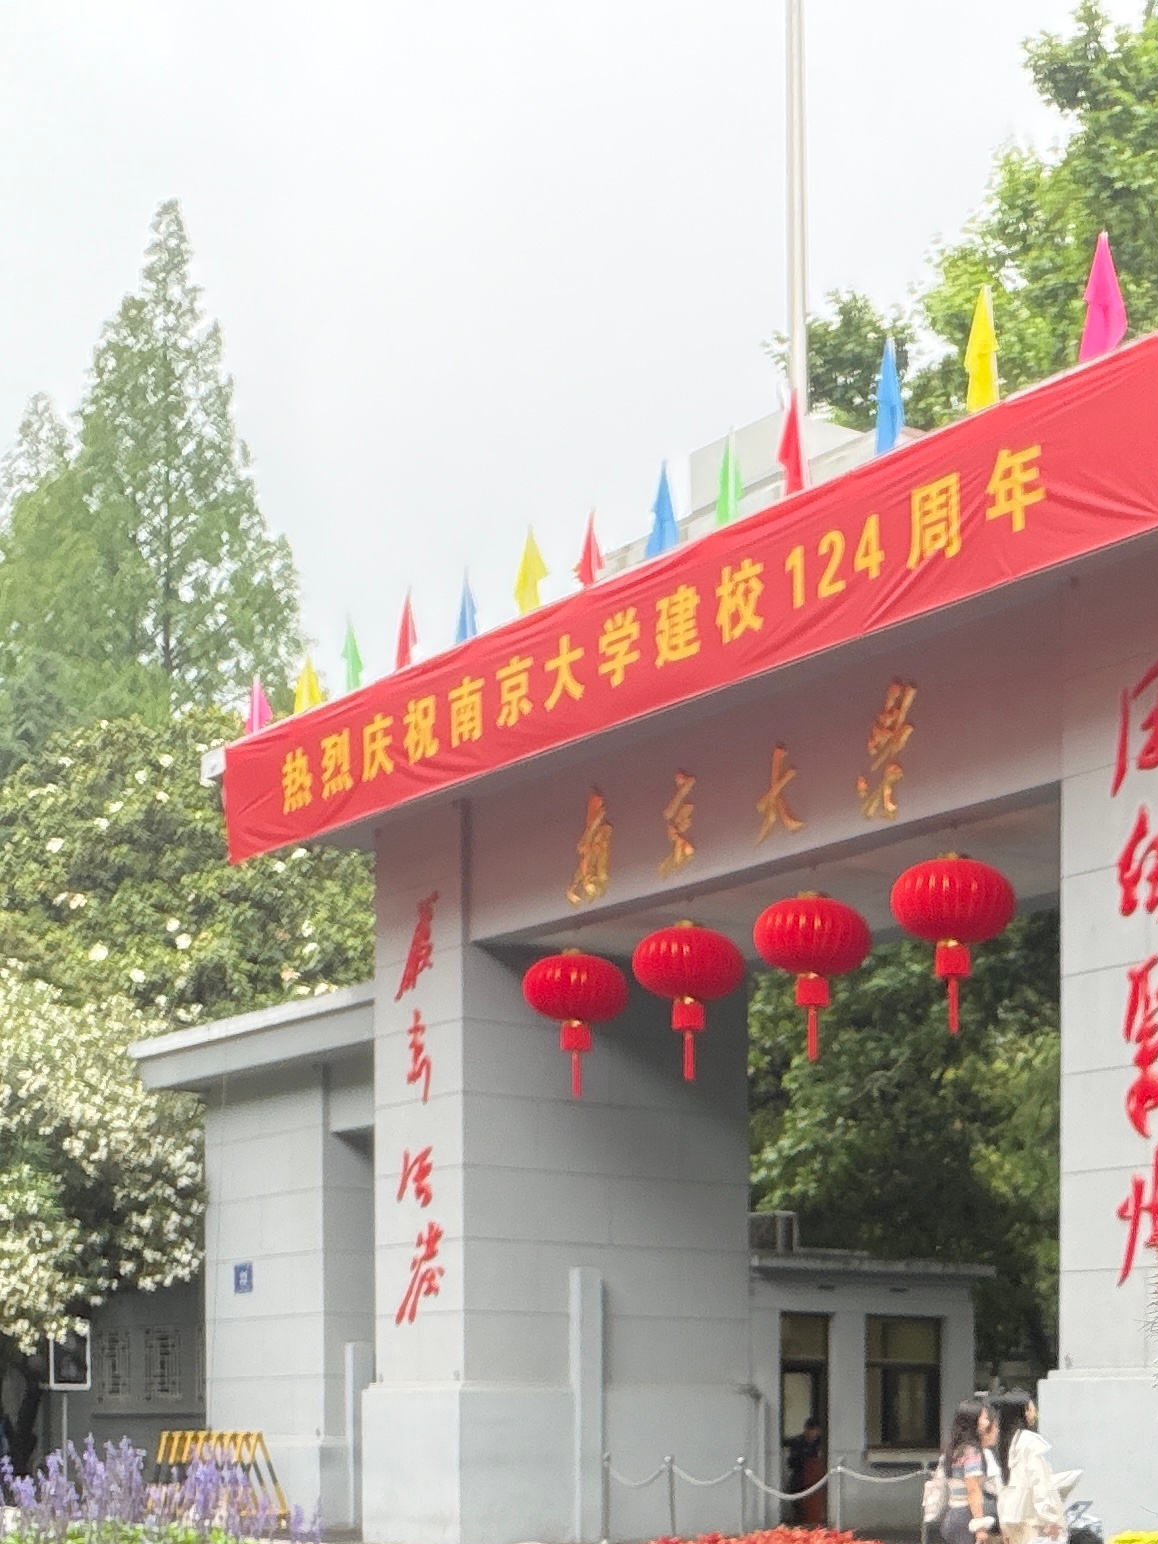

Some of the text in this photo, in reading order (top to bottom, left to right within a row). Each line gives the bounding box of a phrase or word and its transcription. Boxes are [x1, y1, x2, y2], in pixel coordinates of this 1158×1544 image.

[281, 443, 1047, 814] 热烈庆祝南京大学建校124周年
